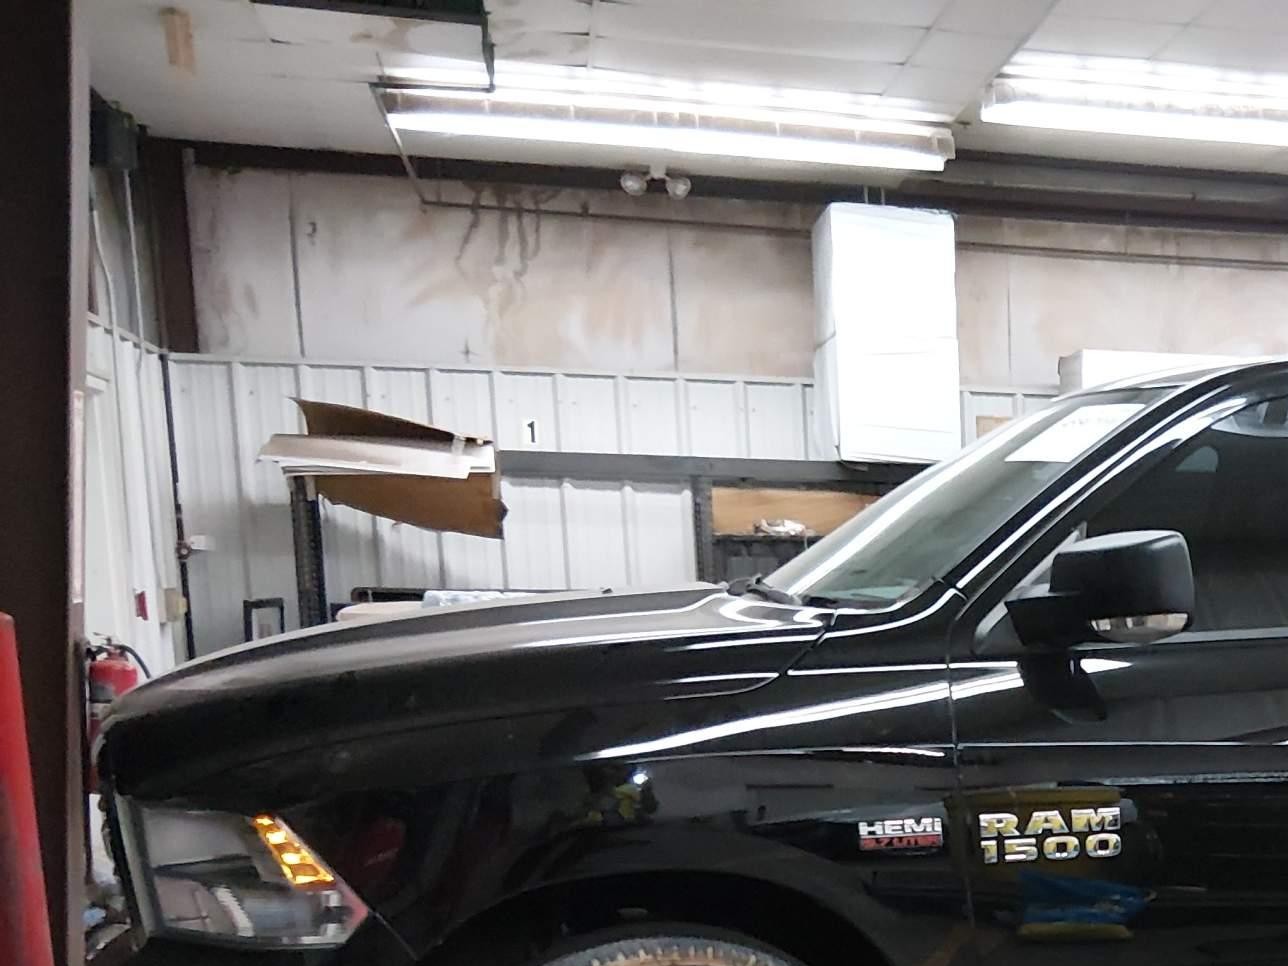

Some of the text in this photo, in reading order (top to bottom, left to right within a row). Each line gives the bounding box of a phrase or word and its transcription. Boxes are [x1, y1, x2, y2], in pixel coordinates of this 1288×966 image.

[527, 420, 536, 443] 1
[858, 817, 942, 835] HEMI
[978, 807, 1121, 838] RAM
[980, 833, 1122, 864] 1500
